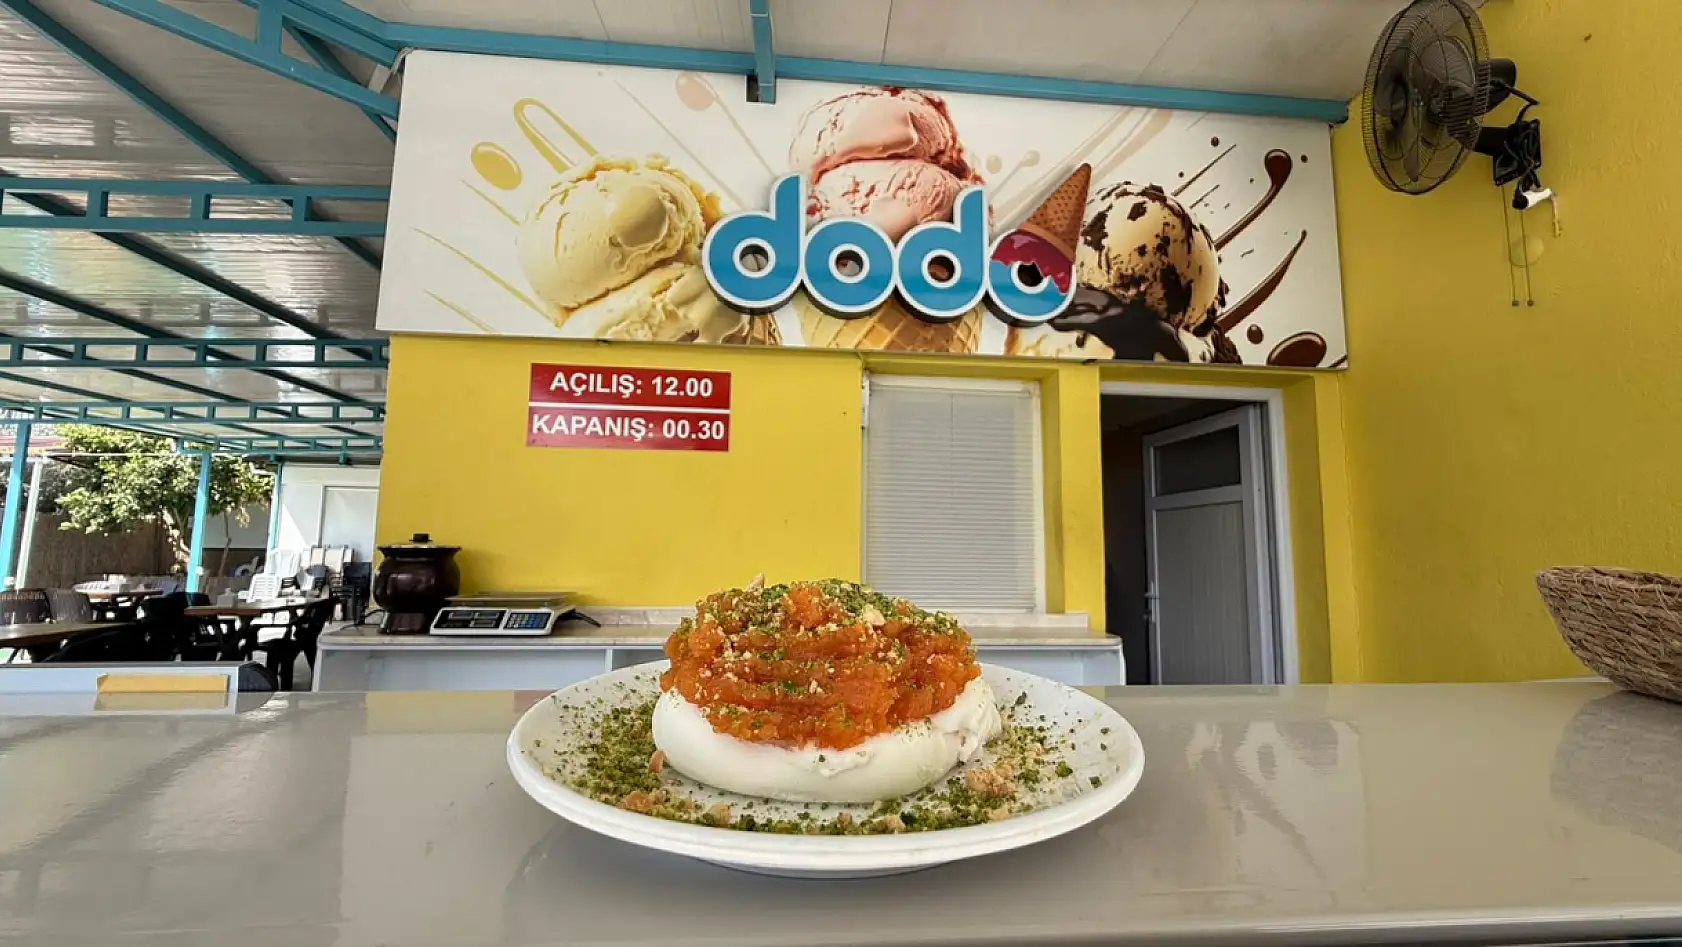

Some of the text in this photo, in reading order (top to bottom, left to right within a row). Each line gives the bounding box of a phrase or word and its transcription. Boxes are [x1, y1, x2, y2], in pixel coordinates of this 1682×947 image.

[702, 172, 1077, 322] dodo
[550, 371, 713, 398] AÇILIŞ: 12.00
[532, 414, 725, 441] KAPANIŞ: 00.30
